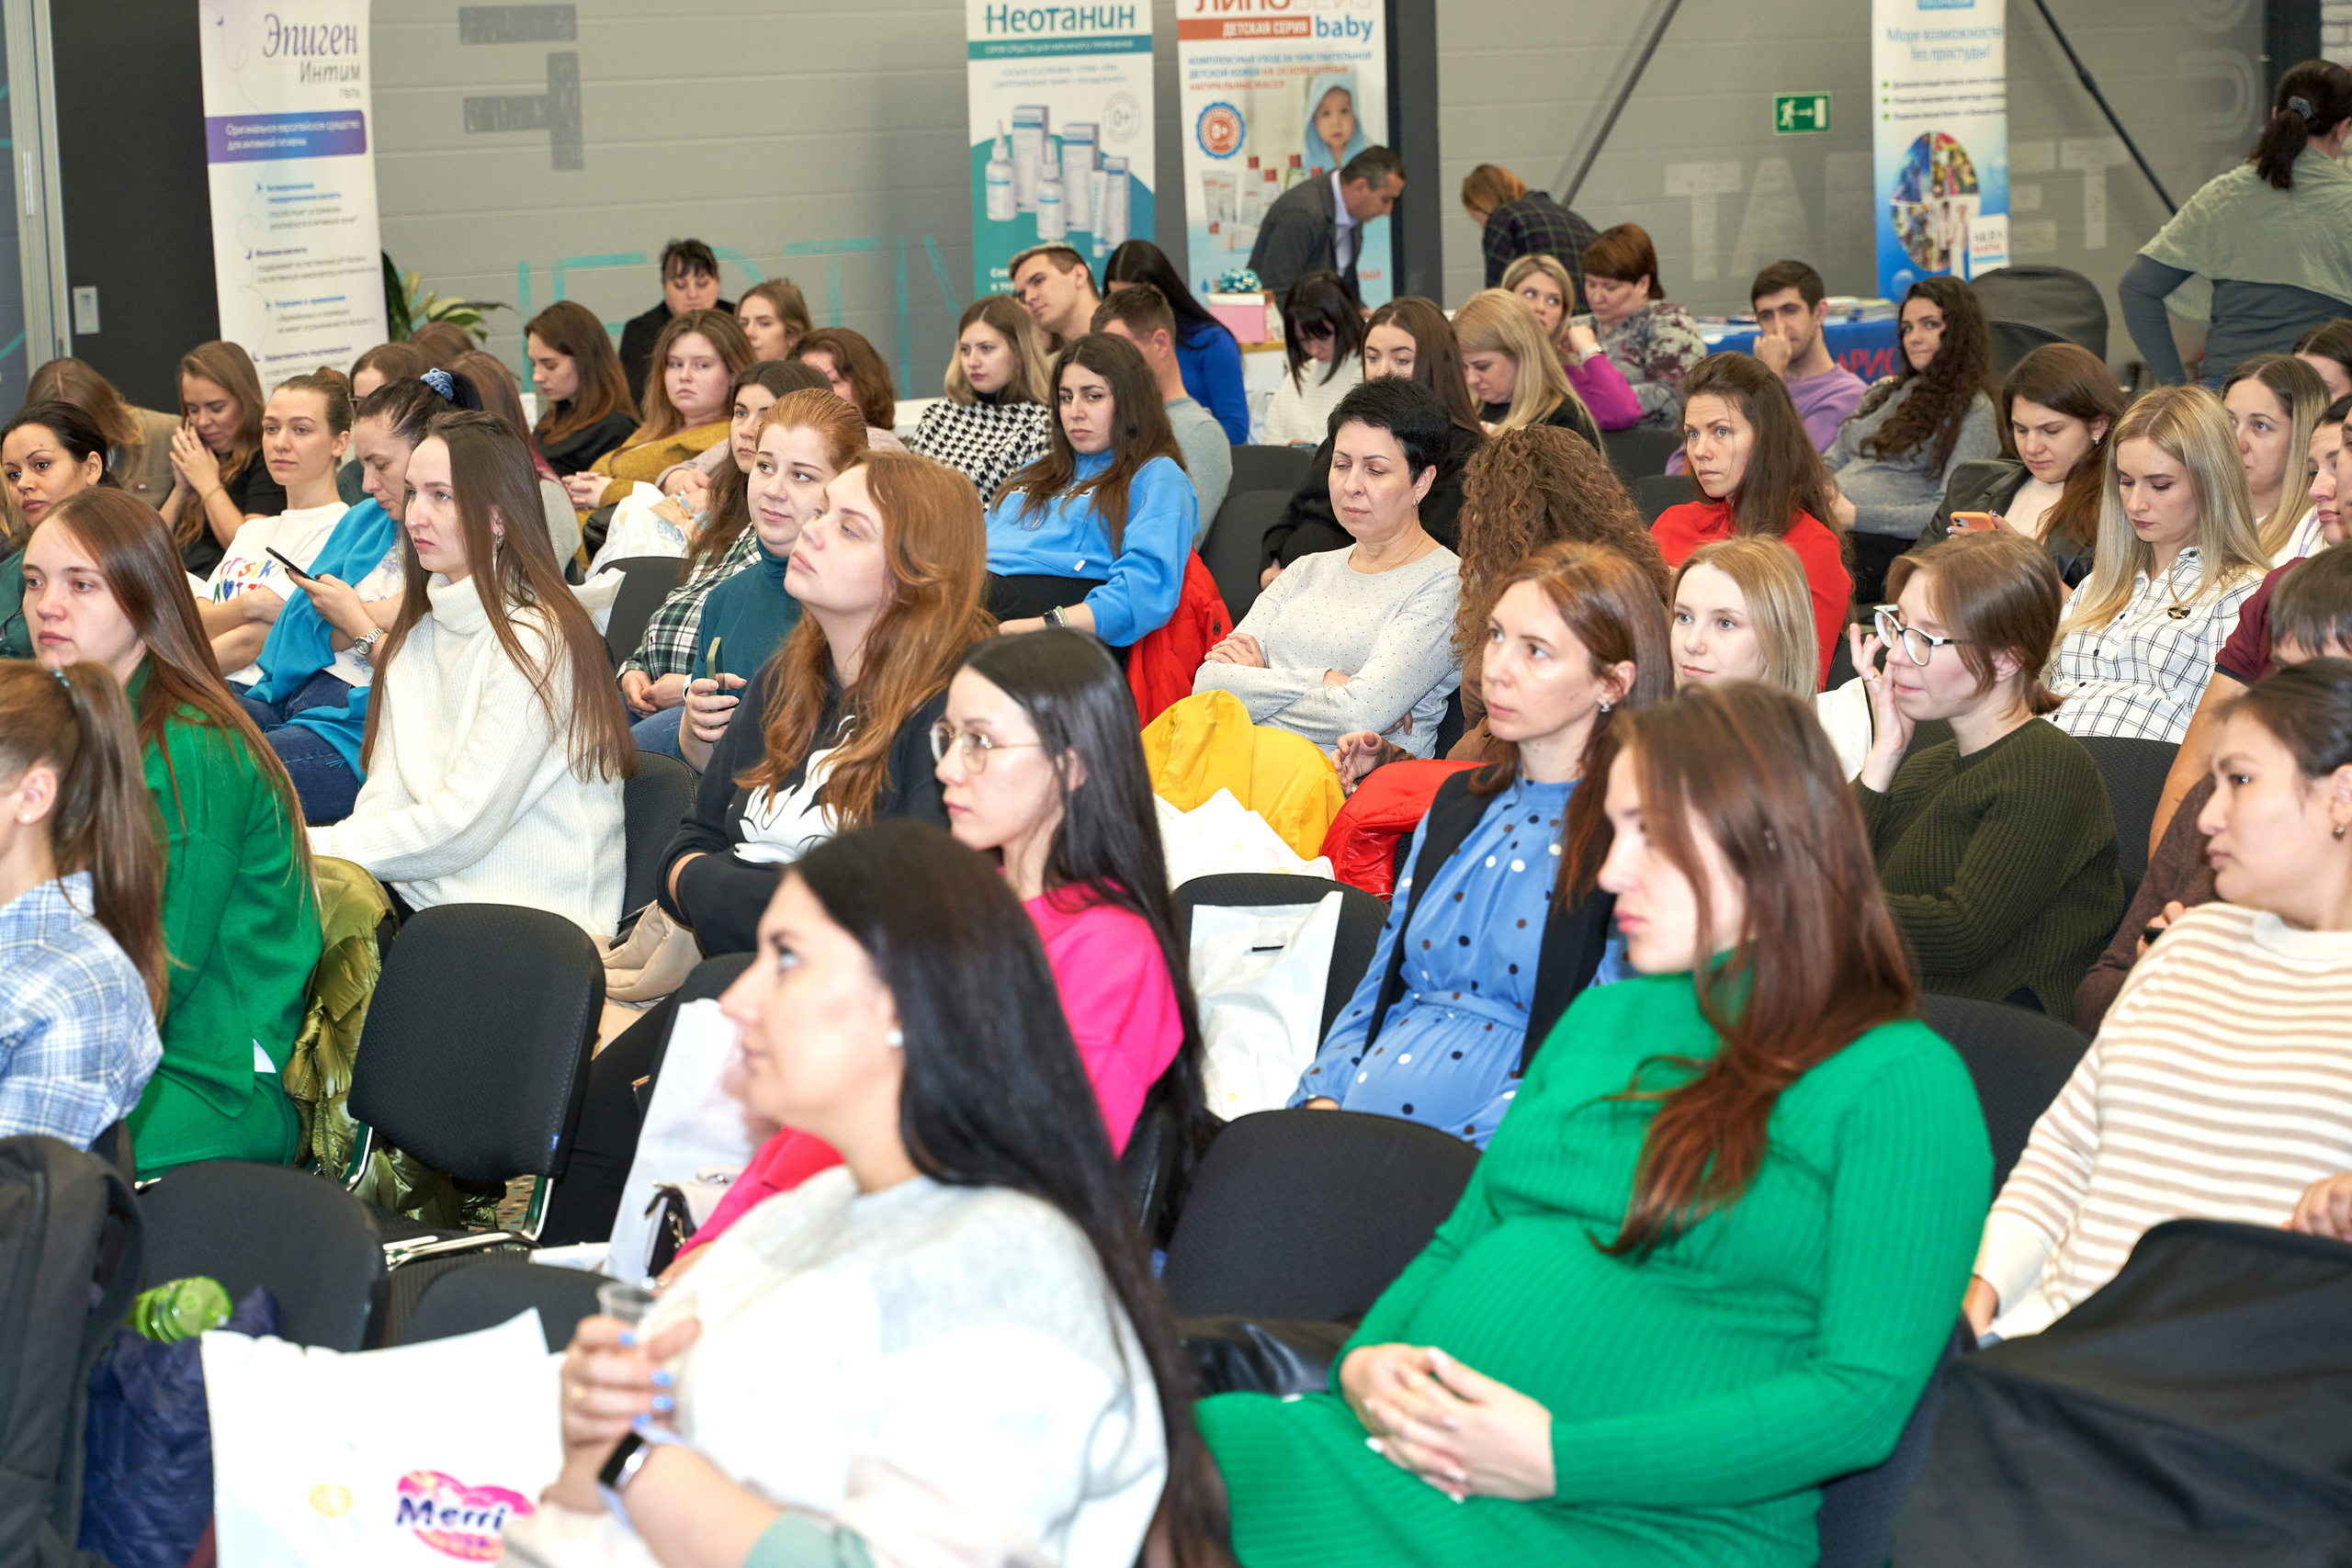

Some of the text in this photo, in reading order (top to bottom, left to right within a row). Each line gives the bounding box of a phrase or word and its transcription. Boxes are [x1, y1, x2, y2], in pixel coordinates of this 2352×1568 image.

[984, 5, 1135, 33] Неотанин
[1222, 20, 1307, 38] ДЕТСКАЯ СЕРИЯ
[1316, 14, 1374, 42] baby
[262, 13, 358, 58] Эпиген
[300, 61, 361, 84] Интим
[396, 1496, 505, 1530] Merri
